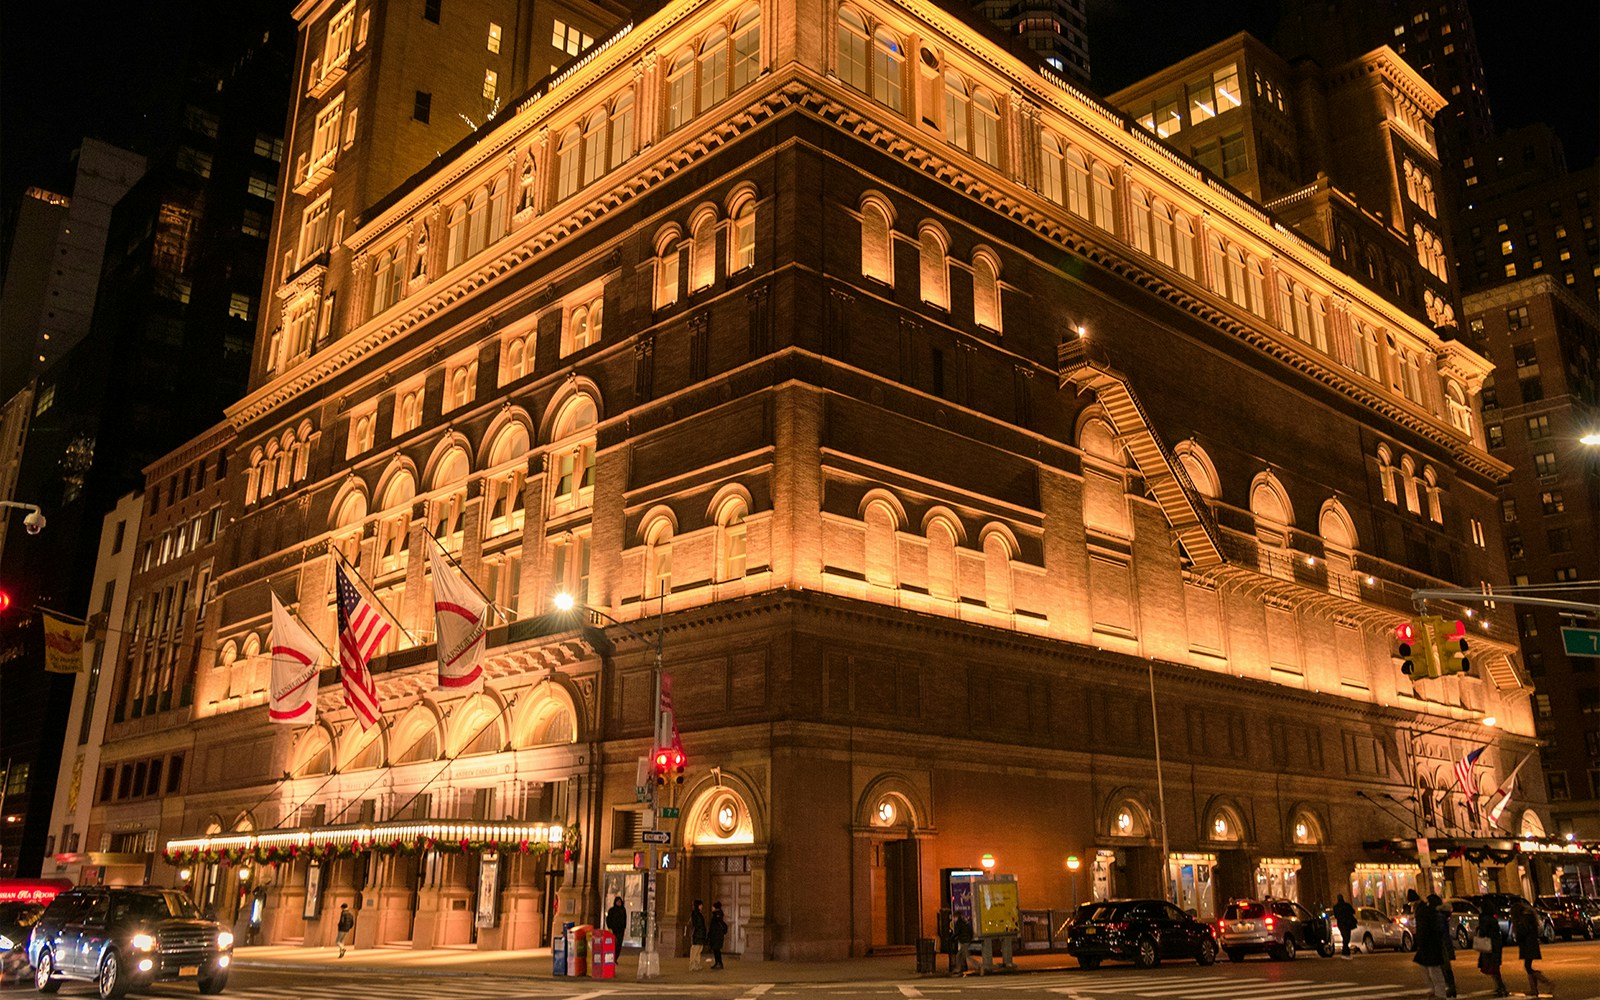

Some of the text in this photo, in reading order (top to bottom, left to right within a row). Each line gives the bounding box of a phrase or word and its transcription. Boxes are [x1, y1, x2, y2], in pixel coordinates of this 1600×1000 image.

[441, 635, 471, 664] CARNEGIE
[1589, 634, 1598, 652] 7
[272, 677, 302, 700] CARNEGIE
